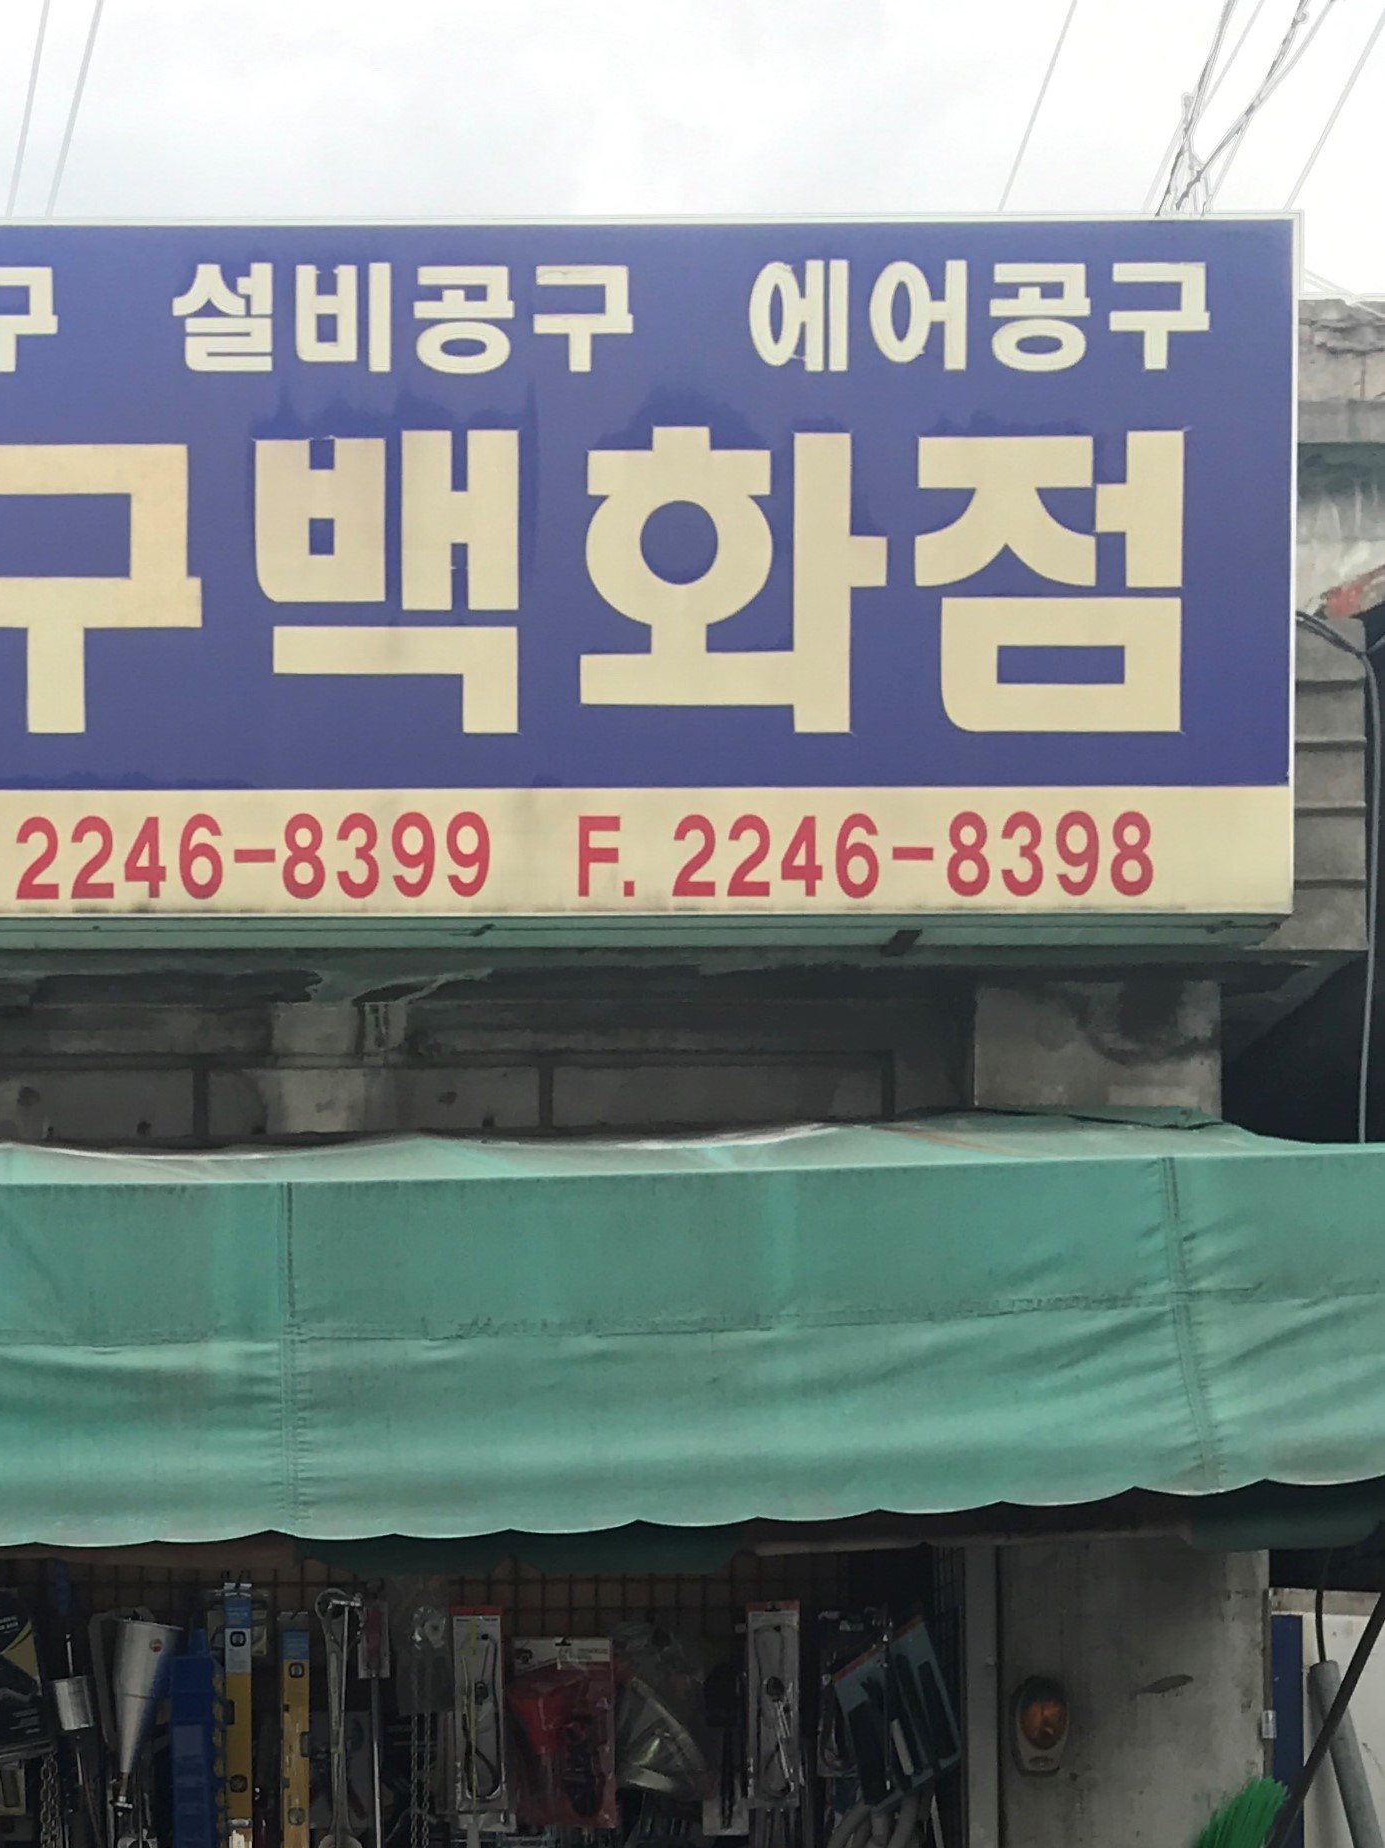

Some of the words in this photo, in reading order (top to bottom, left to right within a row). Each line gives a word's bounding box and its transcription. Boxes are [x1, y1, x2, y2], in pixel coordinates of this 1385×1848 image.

[171, 261, 634, 373] 설비공구
[749, 258, 1211, 373] 에어공구
[14, 812, 491, 901] 2246-8399
[575, 815, 637, 899] F.
[671, 810, 1156, 899] 2246-8398
